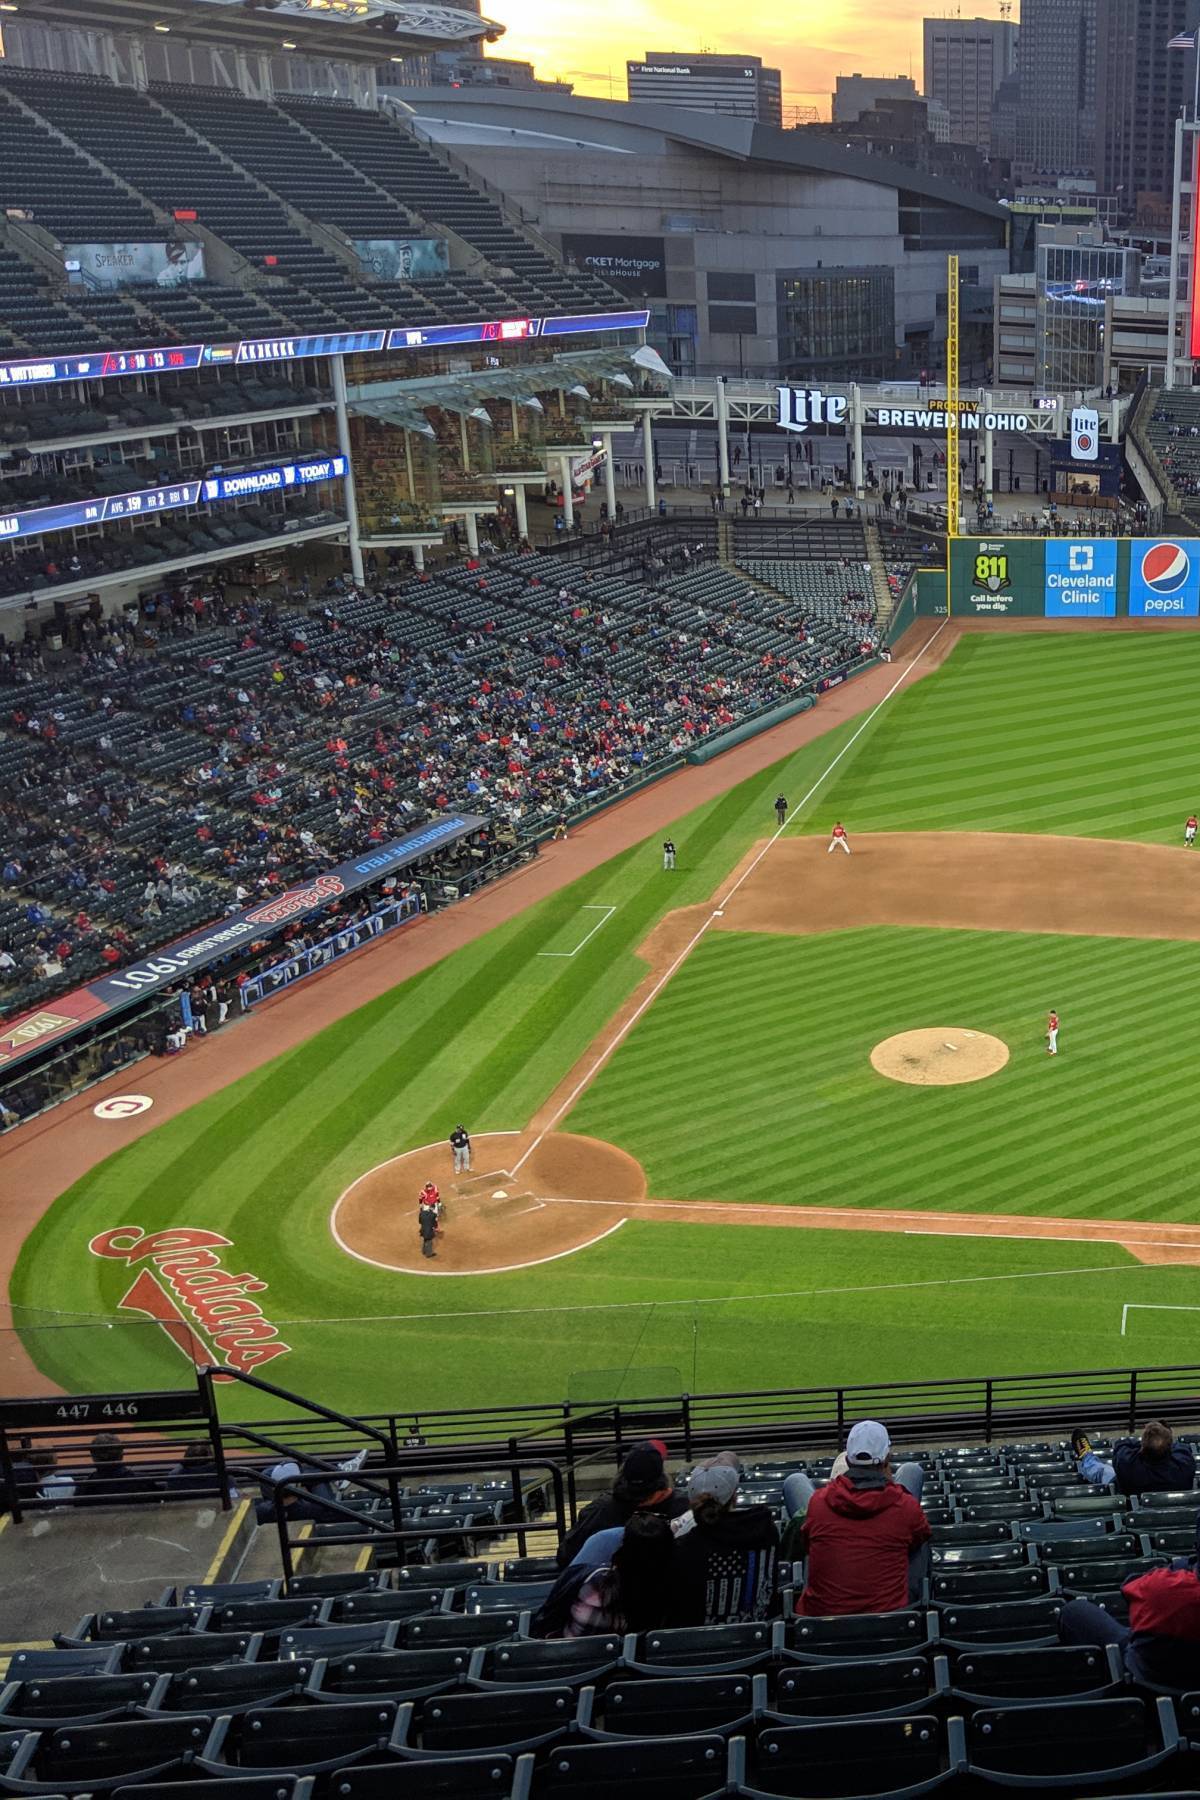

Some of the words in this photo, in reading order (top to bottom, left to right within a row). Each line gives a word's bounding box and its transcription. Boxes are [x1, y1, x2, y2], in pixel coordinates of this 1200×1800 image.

[96, 253, 135, 268] SPEAKER
[615, 258, 660, 269] Mortgage
[775, 386, 848, 431] Lite
[929, 400, 979, 412] PRODLY
[1039, 399, 1057, 409] 8:29
[961, 412, 979, 429] IN
[984, 413, 1028, 430] OHIO
[1073, 416, 1097, 433] Lite
[223, 472, 281, 494] DOWNLOAD
[298, 463, 331, 480] TODAY
[111, 502, 124, 513] AVG
[976, 556, 1007, 579] 811
[1047, 575, 1115, 589] Cleveland
[970, 595, 985, 603] Call
[987, 595, 1013, 603] before
[1061, 590, 1100, 605] Clinic
[1145, 597, 1185, 613] pepsi
[976, 603, 992, 612] you
[992, 602, 1008, 612] dig.
[396, 818, 466, 857] PROGRESSIVE
[354, 852, 396, 875] FIELD
[244, 875, 346, 926] Indians
[183, 922, 254, 961] ESTABLISHED
[109, 953, 188, 993] 1901
[17, 1018, 63, 1038] 1920
[104, 1100, 144, 1114] C
[88, 1225, 293, 1376] Indians
[56, 1404, 91, 1418] 447
[102, 1402, 139, 1416] 446
